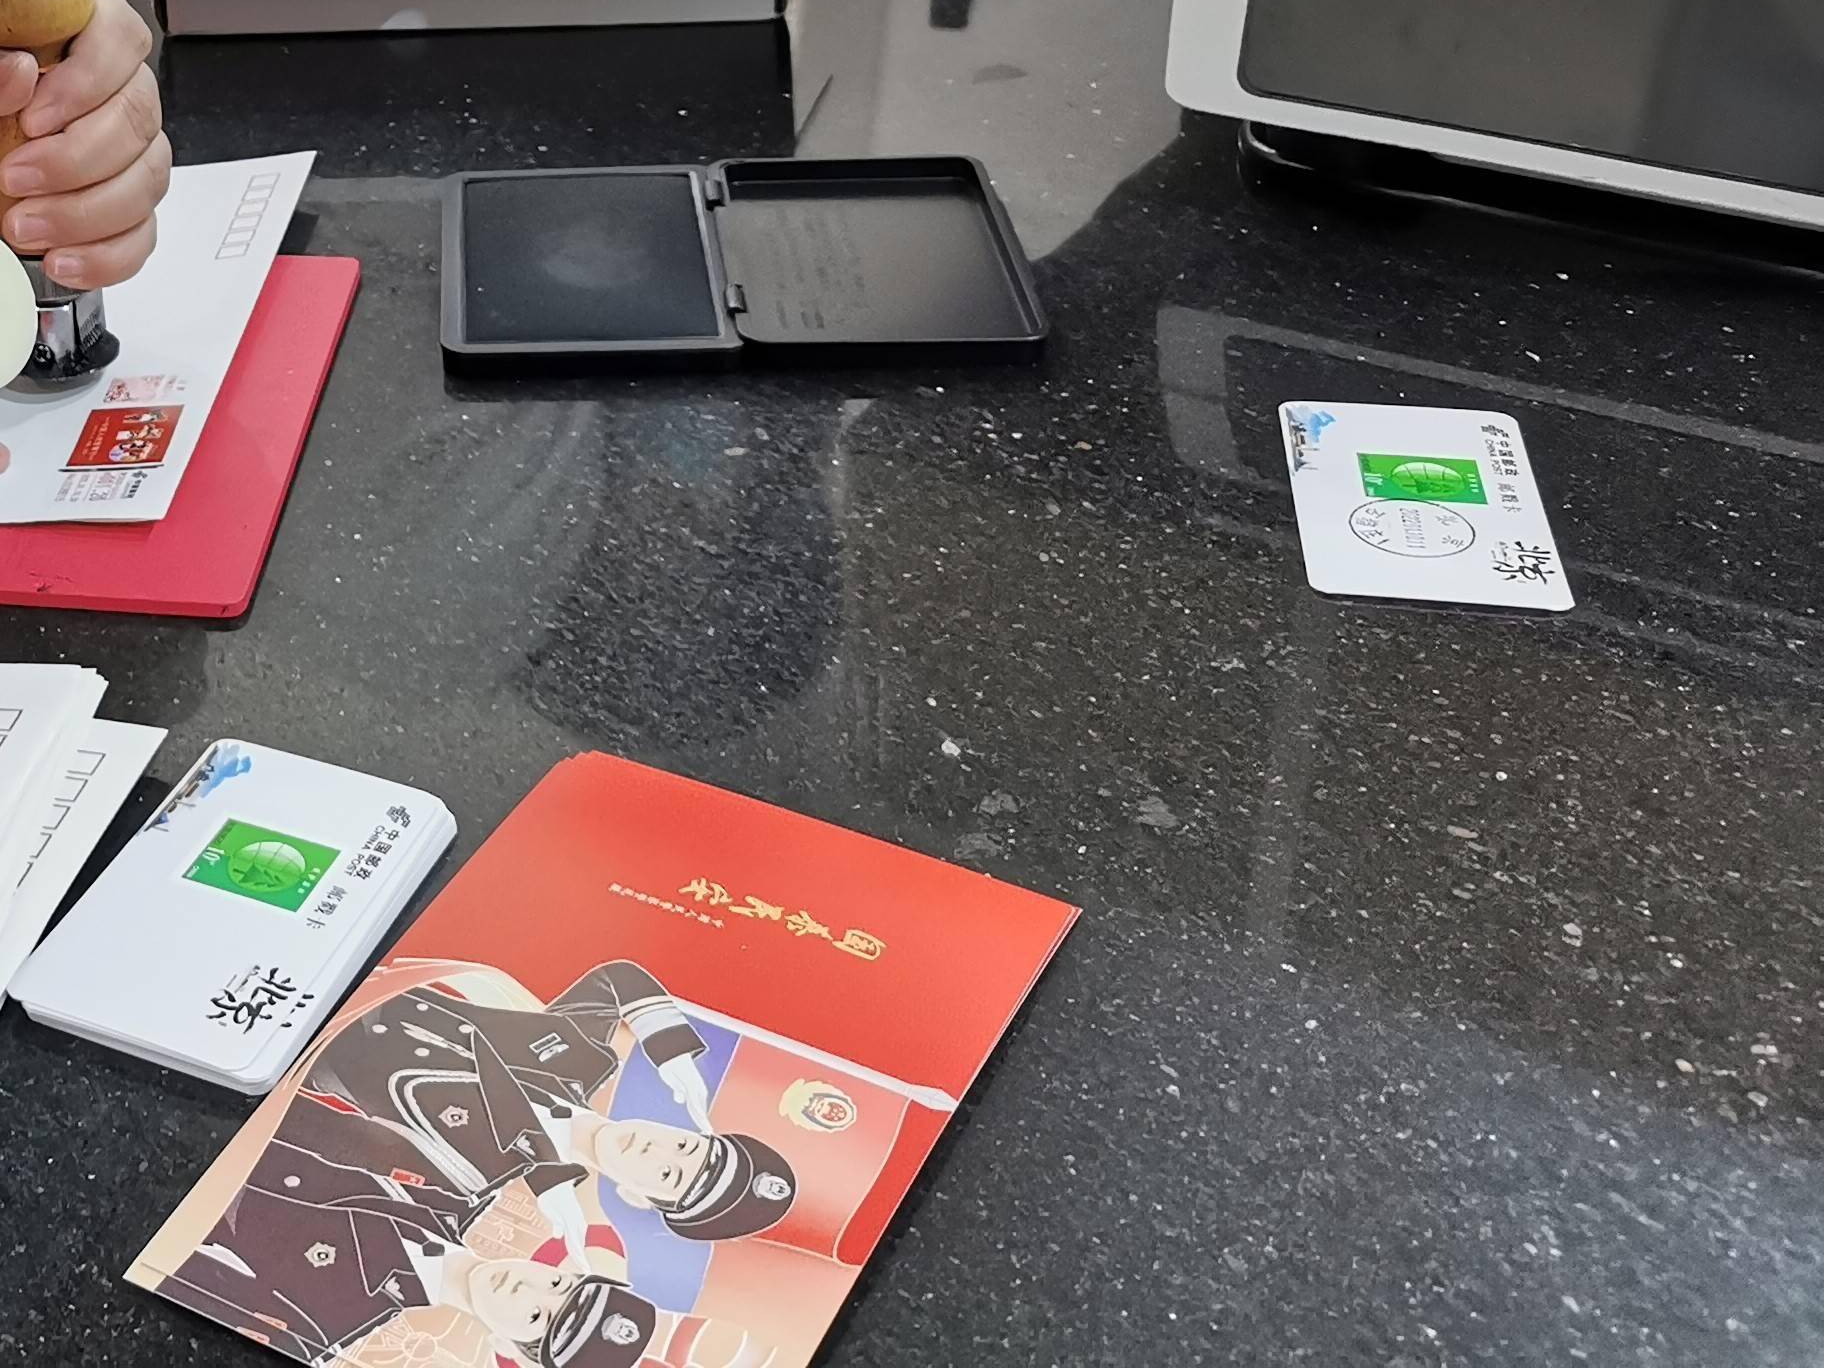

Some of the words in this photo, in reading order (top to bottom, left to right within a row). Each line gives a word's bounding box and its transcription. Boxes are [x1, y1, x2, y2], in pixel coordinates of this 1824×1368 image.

[1492, 541, 1556, 585] 北京
[356, 829, 400, 881] 中国邮政
[362, 825, 386, 851] CHINA
[345, 854, 365, 877] POST
[206, 967, 297, 1034] 北京
